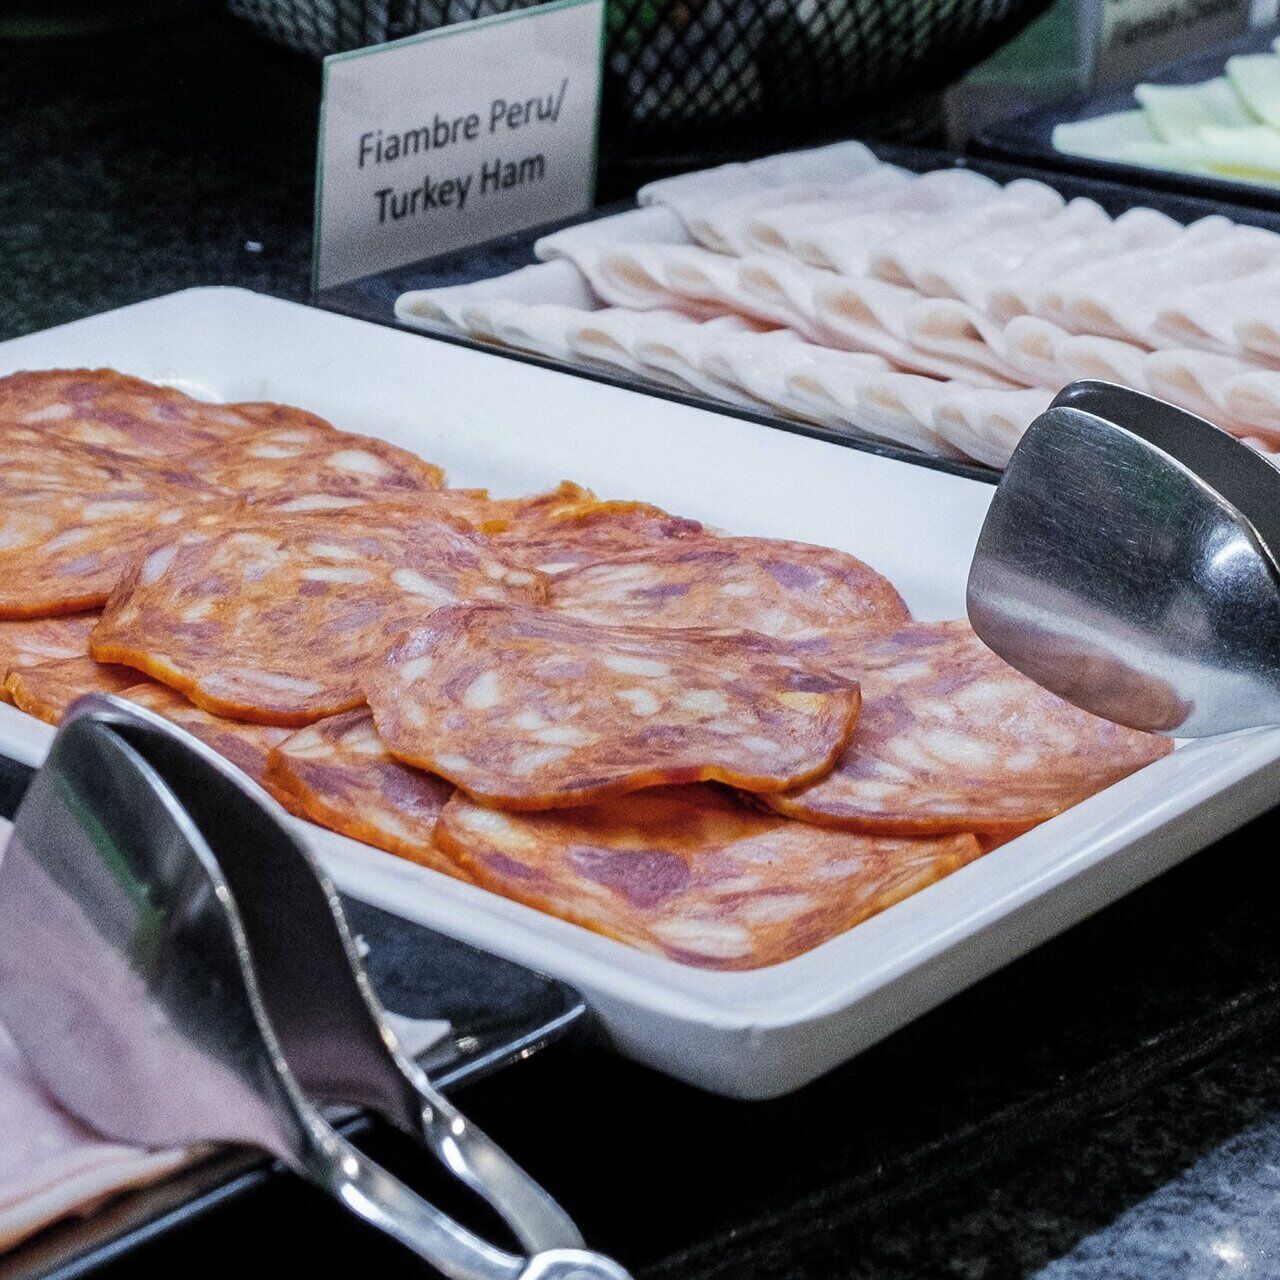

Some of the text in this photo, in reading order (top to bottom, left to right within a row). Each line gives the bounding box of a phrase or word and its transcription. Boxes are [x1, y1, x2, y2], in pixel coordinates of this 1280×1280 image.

[357, 77, 570, 170] Fiambre Peru/
[373, 151, 547, 223] Turkey Ham
